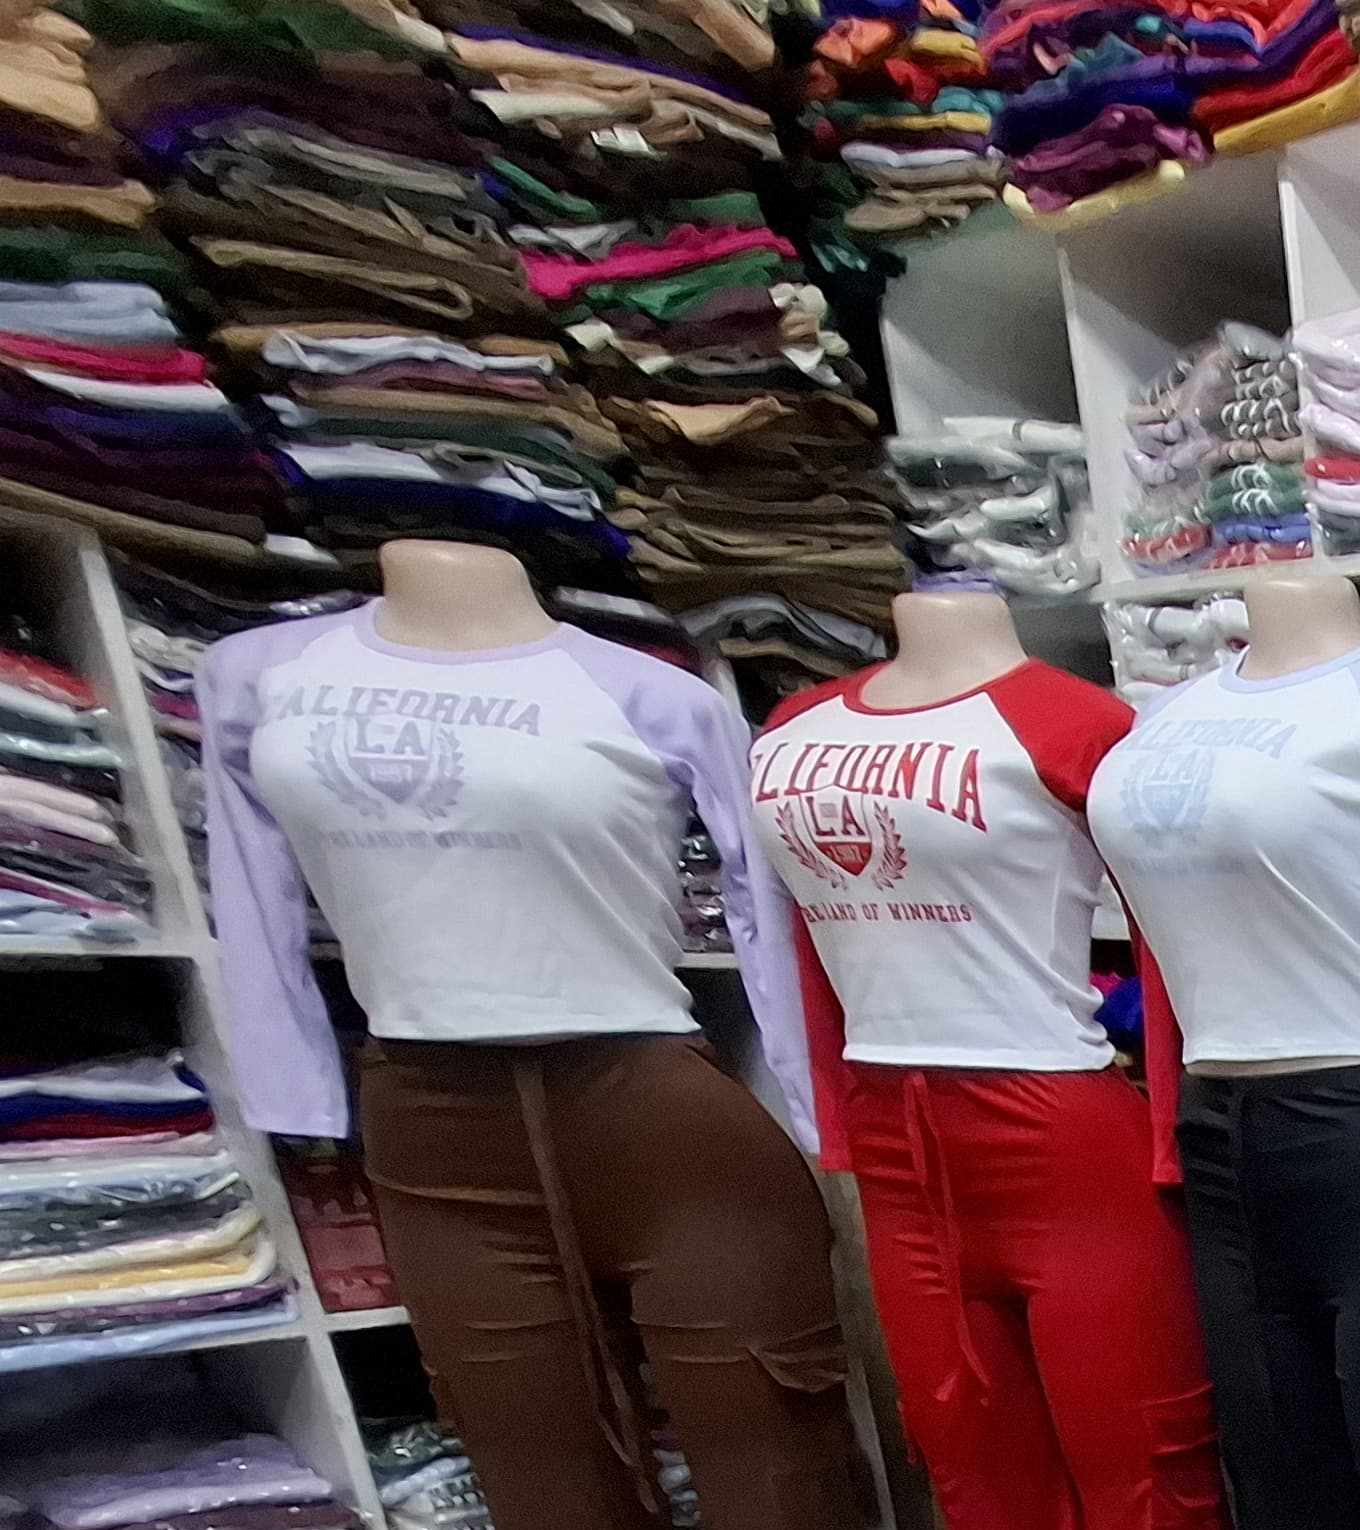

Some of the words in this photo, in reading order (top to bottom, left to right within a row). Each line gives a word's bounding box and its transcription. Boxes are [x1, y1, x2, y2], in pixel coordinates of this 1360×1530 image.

[276, 684, 541, 736] ALIFORNIA
[754, 742, 987, 833] LIFORNIA
[861, 903, 879, 921] OF
[886, 903, 973, 923] WINNERS
